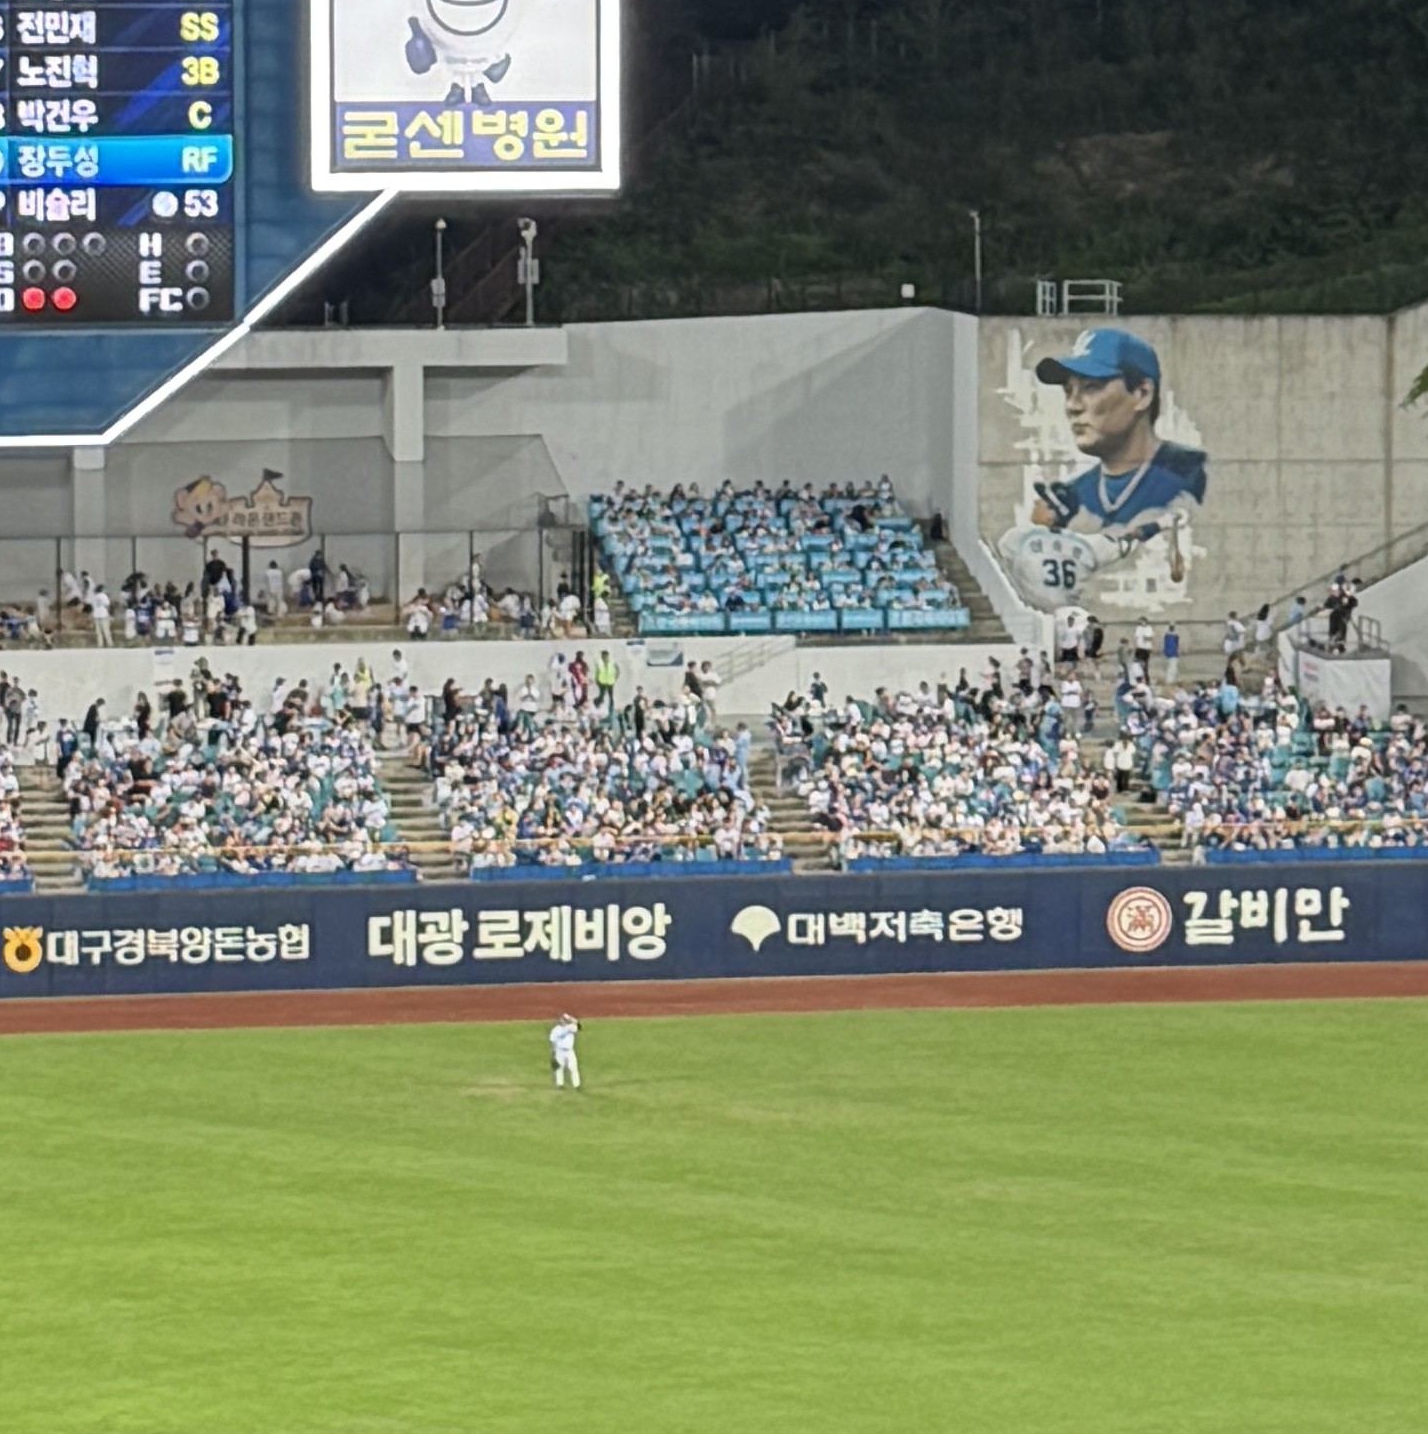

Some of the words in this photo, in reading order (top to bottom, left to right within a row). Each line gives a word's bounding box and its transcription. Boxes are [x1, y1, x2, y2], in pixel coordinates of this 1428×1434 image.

[180, 11, 220, 41] SS
[181, 56, 220, 86] 3B
[17, 99, 99, 133] 박건우
[187, 101, 213, 130] C
[343, 108, 589, 161] 굳센병원
[18, 144, 99, 179] 장두성
[181, 146, 218, 173] RF
[184, 189, 219, 217] 53
[139, 232, 162, 257] H
[139, 260, 162, 284] E
[139, 287, 184, 312] FC
[1043, 559, 1076, 589] 36
[786, 906, 1024, 946] 대백저축은행
[1183, 886, 1351, 945] 갈비만
[47, 923, 311, 966] 대구경북양돈농협
[368, 907, 470, 967] 대광
[472, 903, 673, 962] 로제비앙
